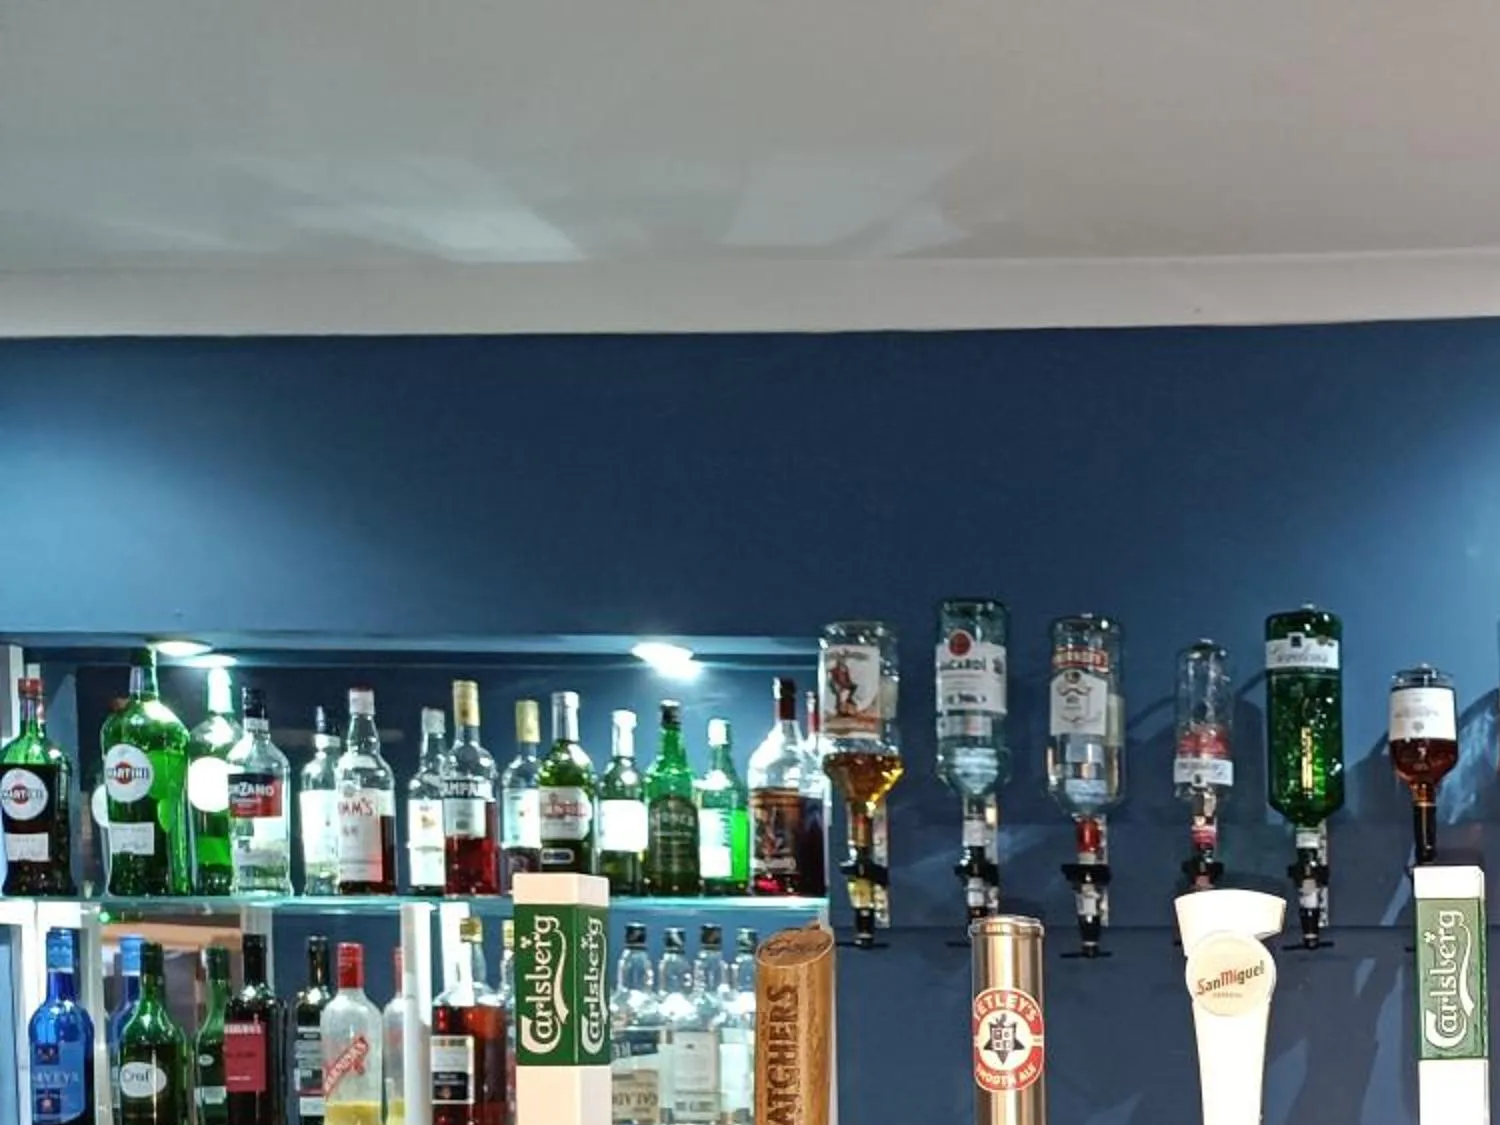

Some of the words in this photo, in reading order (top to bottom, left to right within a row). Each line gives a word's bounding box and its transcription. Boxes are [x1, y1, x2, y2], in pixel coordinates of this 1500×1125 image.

[520, 914, 569, 1054] Carlsberg
[581, 916, 609, 1054] Carlsberg
[1424, 909, 1475, 1049] Carlsberg
